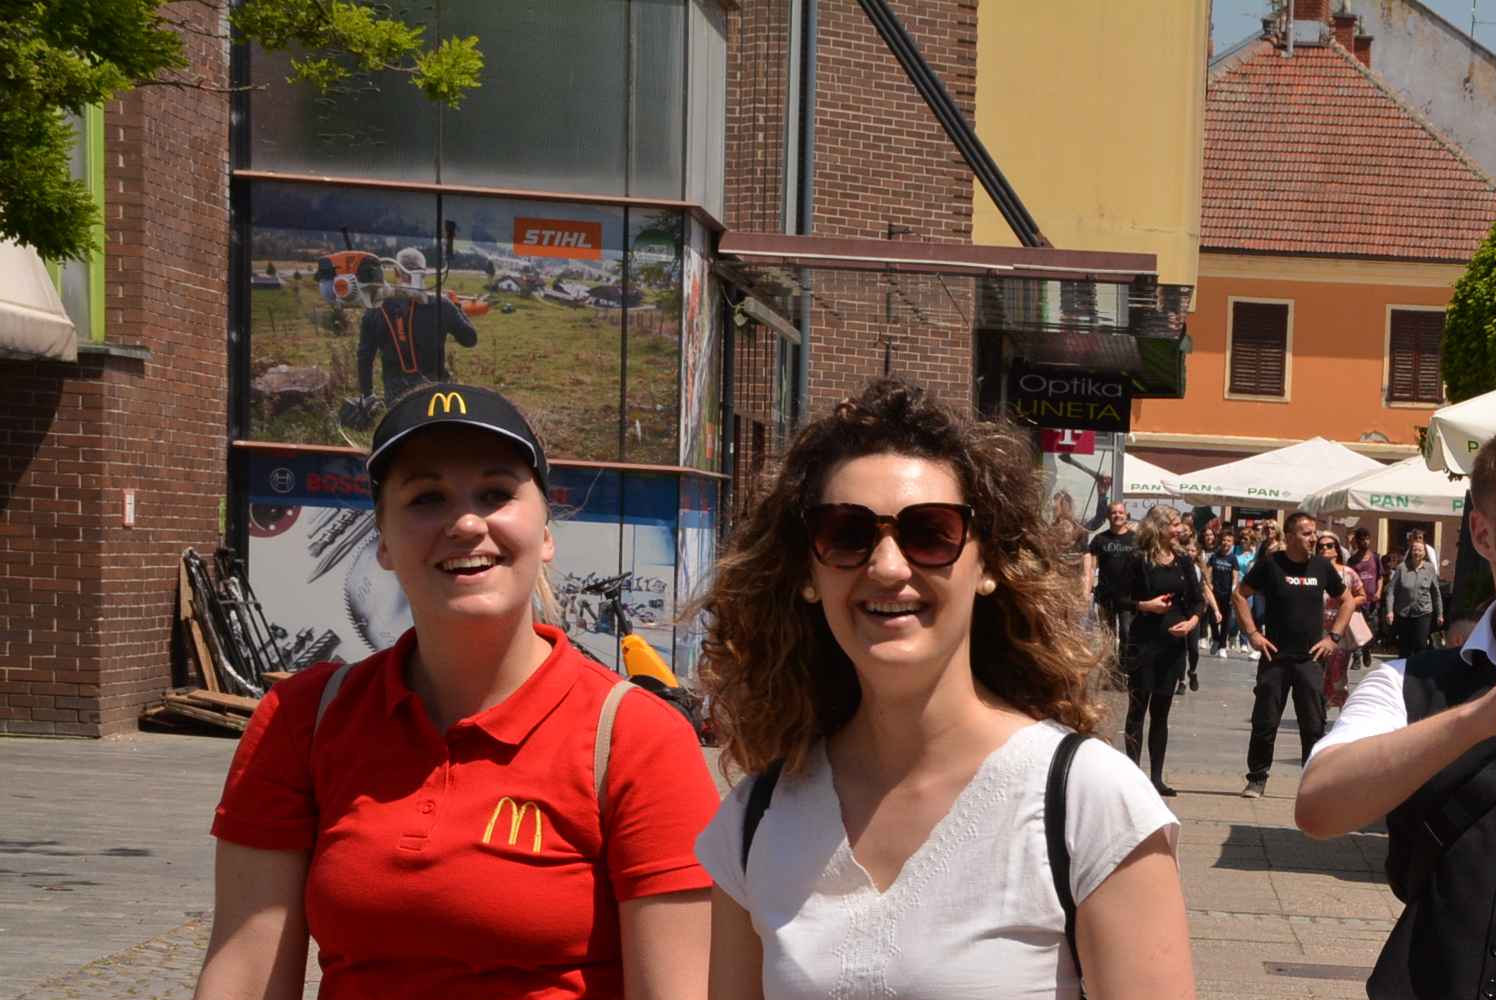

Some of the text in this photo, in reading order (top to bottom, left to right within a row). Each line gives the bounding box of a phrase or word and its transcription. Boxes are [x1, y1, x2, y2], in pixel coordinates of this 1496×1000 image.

[523, 229, 592, 248] STIHL
[1020, 375, 1122, 397] Optika
[306, 472, 371, 494] BOSC
[1179, 483, 1212, 492] PAN
[1247, 488, 1280, 497] PAN
[1370, 495, 1409, 508] PAN
